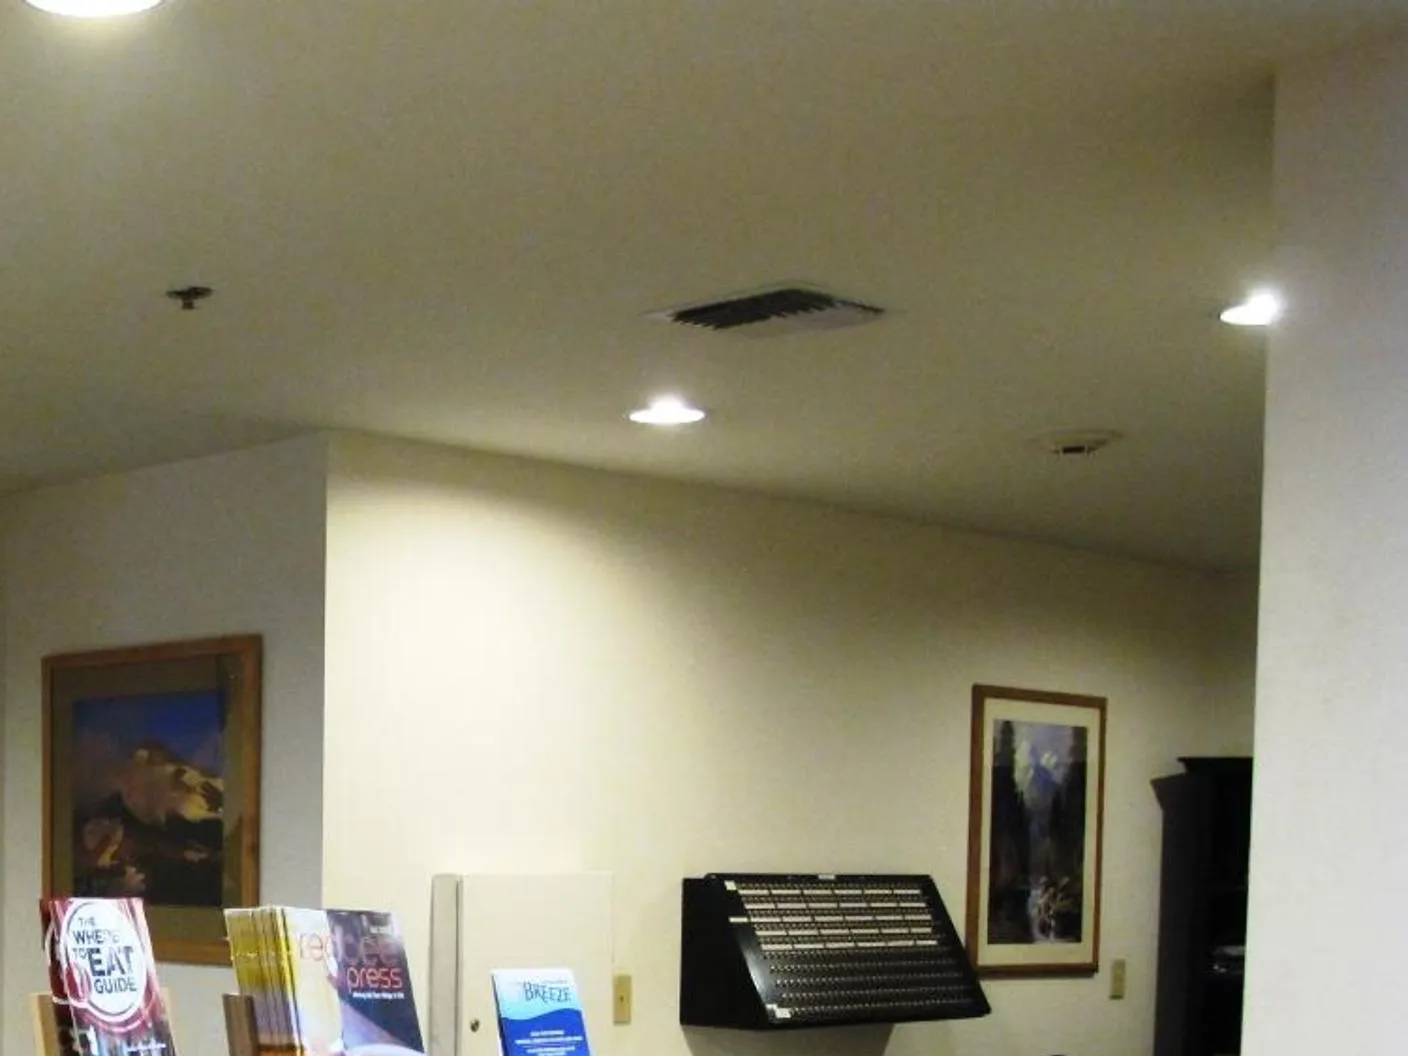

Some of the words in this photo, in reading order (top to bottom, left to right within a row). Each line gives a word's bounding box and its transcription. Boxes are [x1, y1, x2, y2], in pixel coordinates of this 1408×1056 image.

[87, 945, 134, 977] EAT
[94, 976, 138, 994] GUIDE
[346, 966, 404, 995] press
[523, 981, 571, 1004] BREEZE
